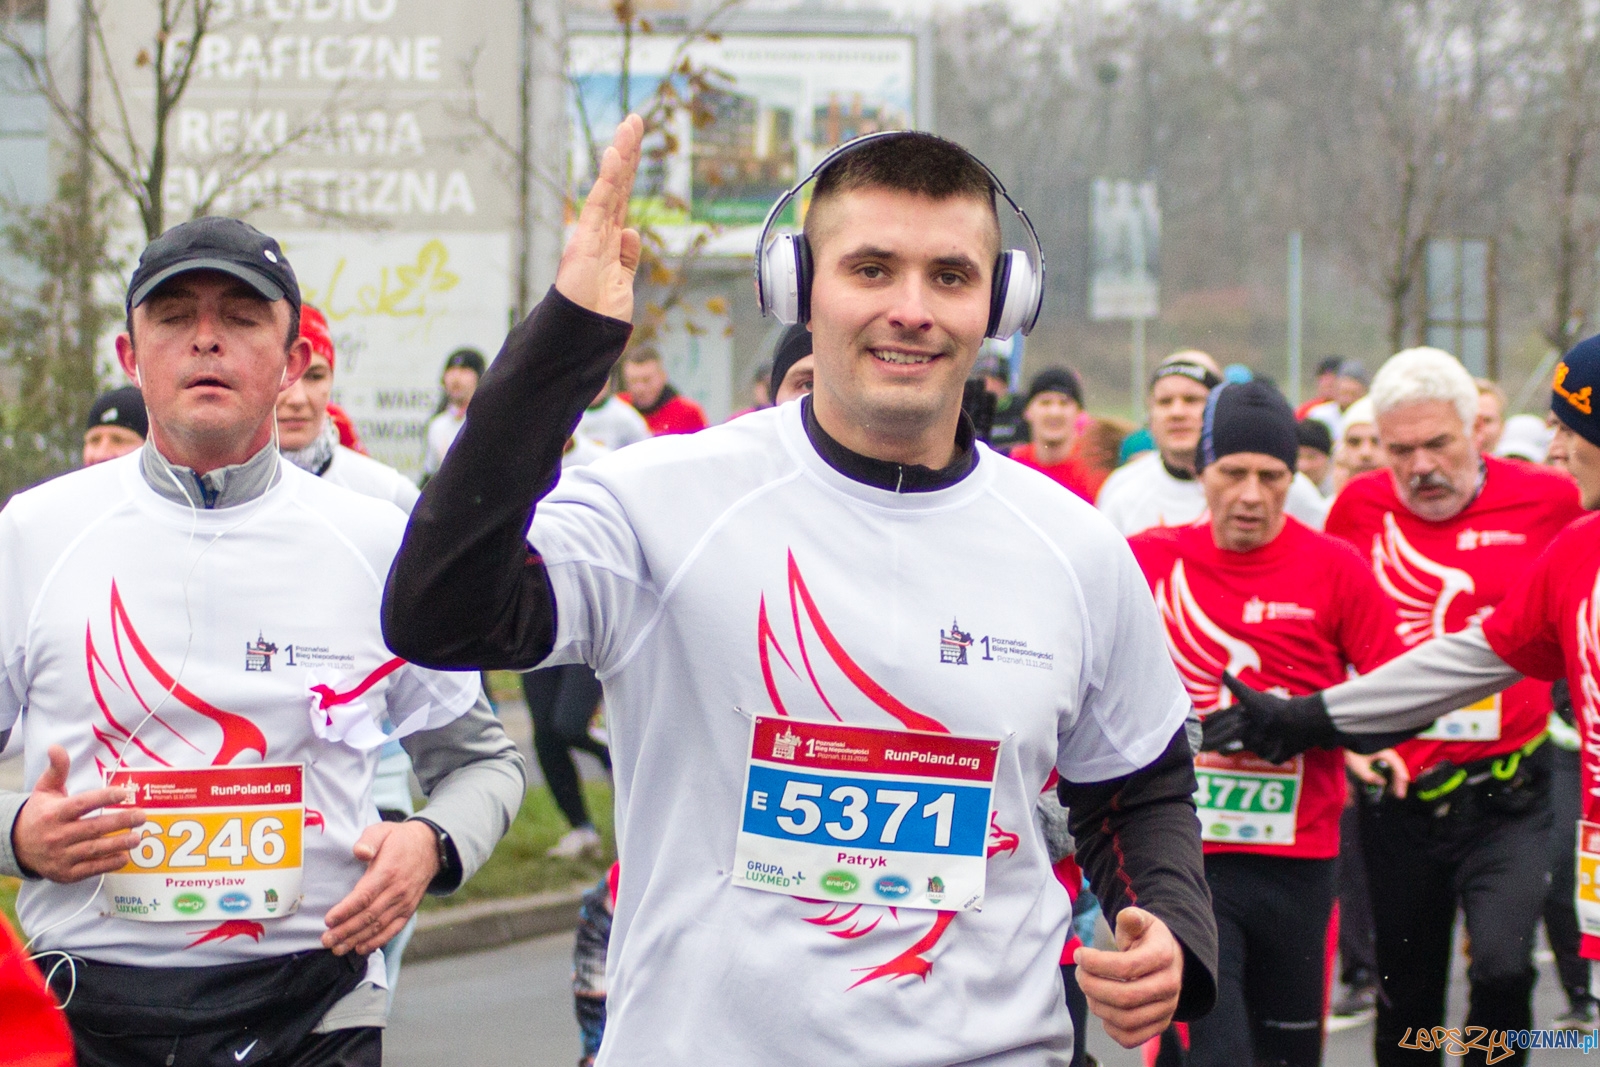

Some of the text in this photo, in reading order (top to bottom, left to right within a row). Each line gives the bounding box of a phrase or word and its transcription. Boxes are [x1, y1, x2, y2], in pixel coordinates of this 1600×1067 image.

[980, 635, 994, 661] 1
[991, 637, 1028, 647] Poznański
[284, 644, 297, 666] 1
[991, 645, 1054, 660] Bieg Niepodległości
[805, 738, 816, 758] 1
[884, 748, 981, 770] RunPoland.org
[210, 783, 292, 796] RunPoland.org
[1193, 775, 1286, 812] 4776
[751, 779, 957, 848] E 5371
[128, 816, 287, 869] 6246
[747, 860, 785, 877] GRUPA
[837, 852, 888, 869] Patryk
[165, 877, 246, 889] Przemysław
[745, 870, 791, 889] LUXMED
[826, 880, 857, 891] energy
[114, 896, 143, 905] GRUPA
